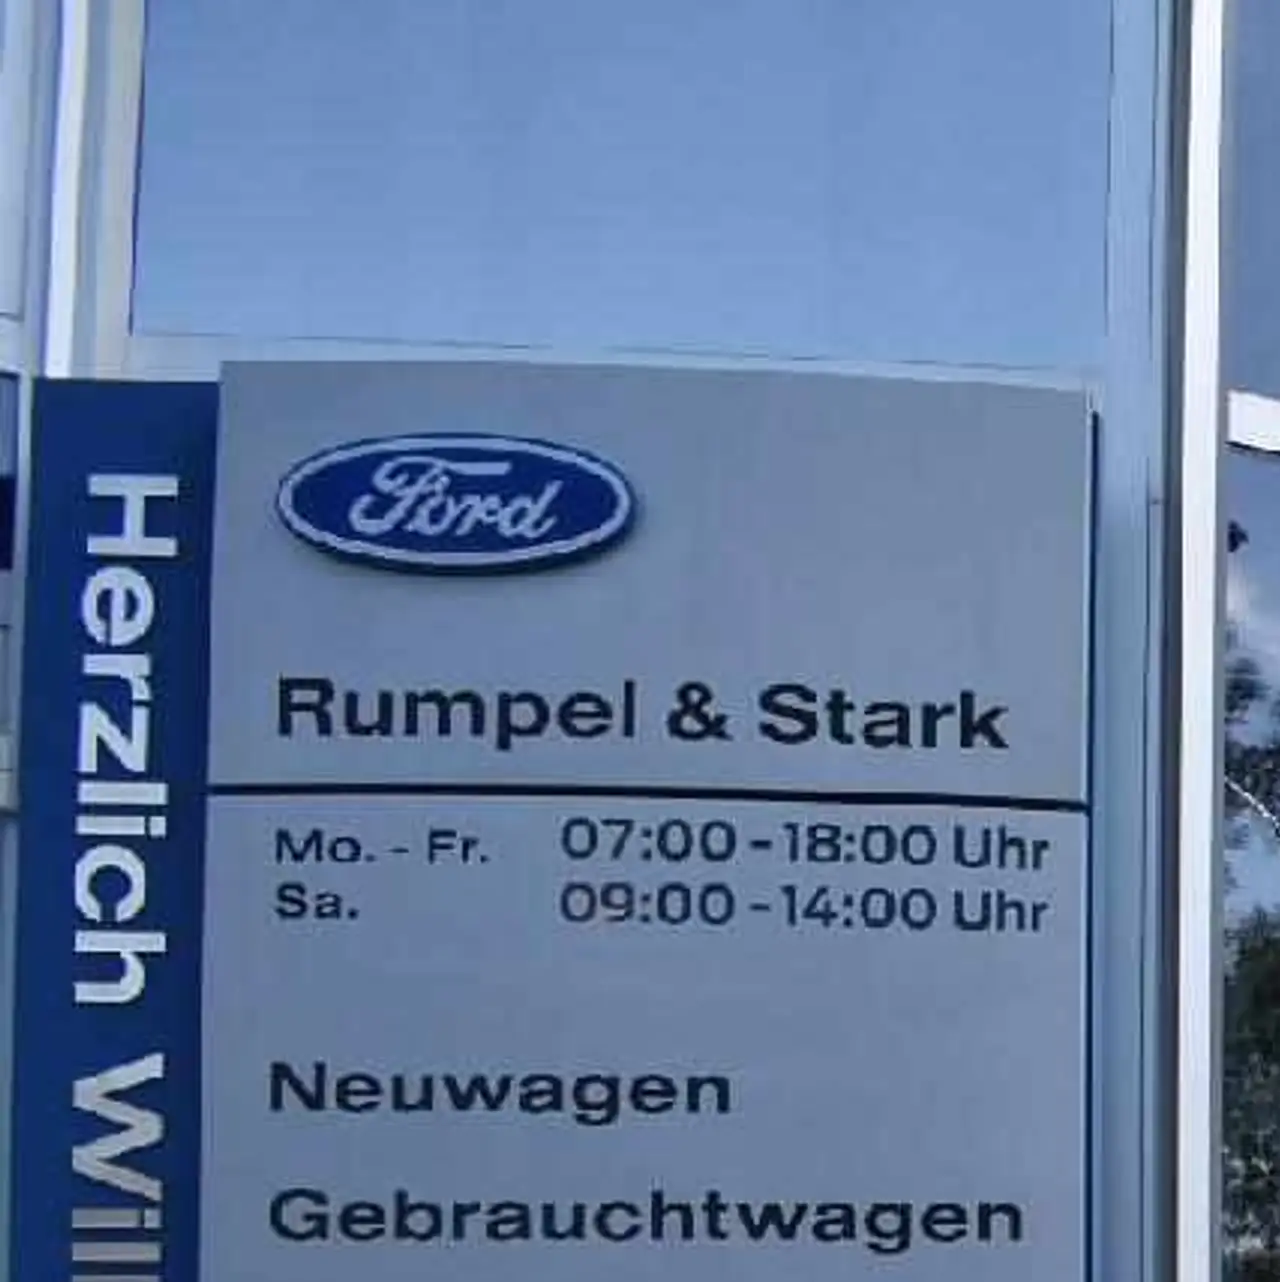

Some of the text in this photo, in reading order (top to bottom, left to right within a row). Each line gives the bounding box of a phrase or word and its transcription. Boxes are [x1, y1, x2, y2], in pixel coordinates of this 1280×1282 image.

[348, 456, 564, 539] Ford
[74, 474, 180, 1003] Herzlich
[277, 675, 1009, 752] Rumpel & Stark
[275, 828, 375, 864] Mo.
[427, 829, 489, 865] Fr.
[952, 825, 1050, 870] Uhr
[275, 884, 359, 920] Sa.
[953, 889, 1049, 932] Uhr
[270, 1061, 731, 1126] Neuwagen
[269, 1188, 1023, 1255] Gebrauchtwagen
